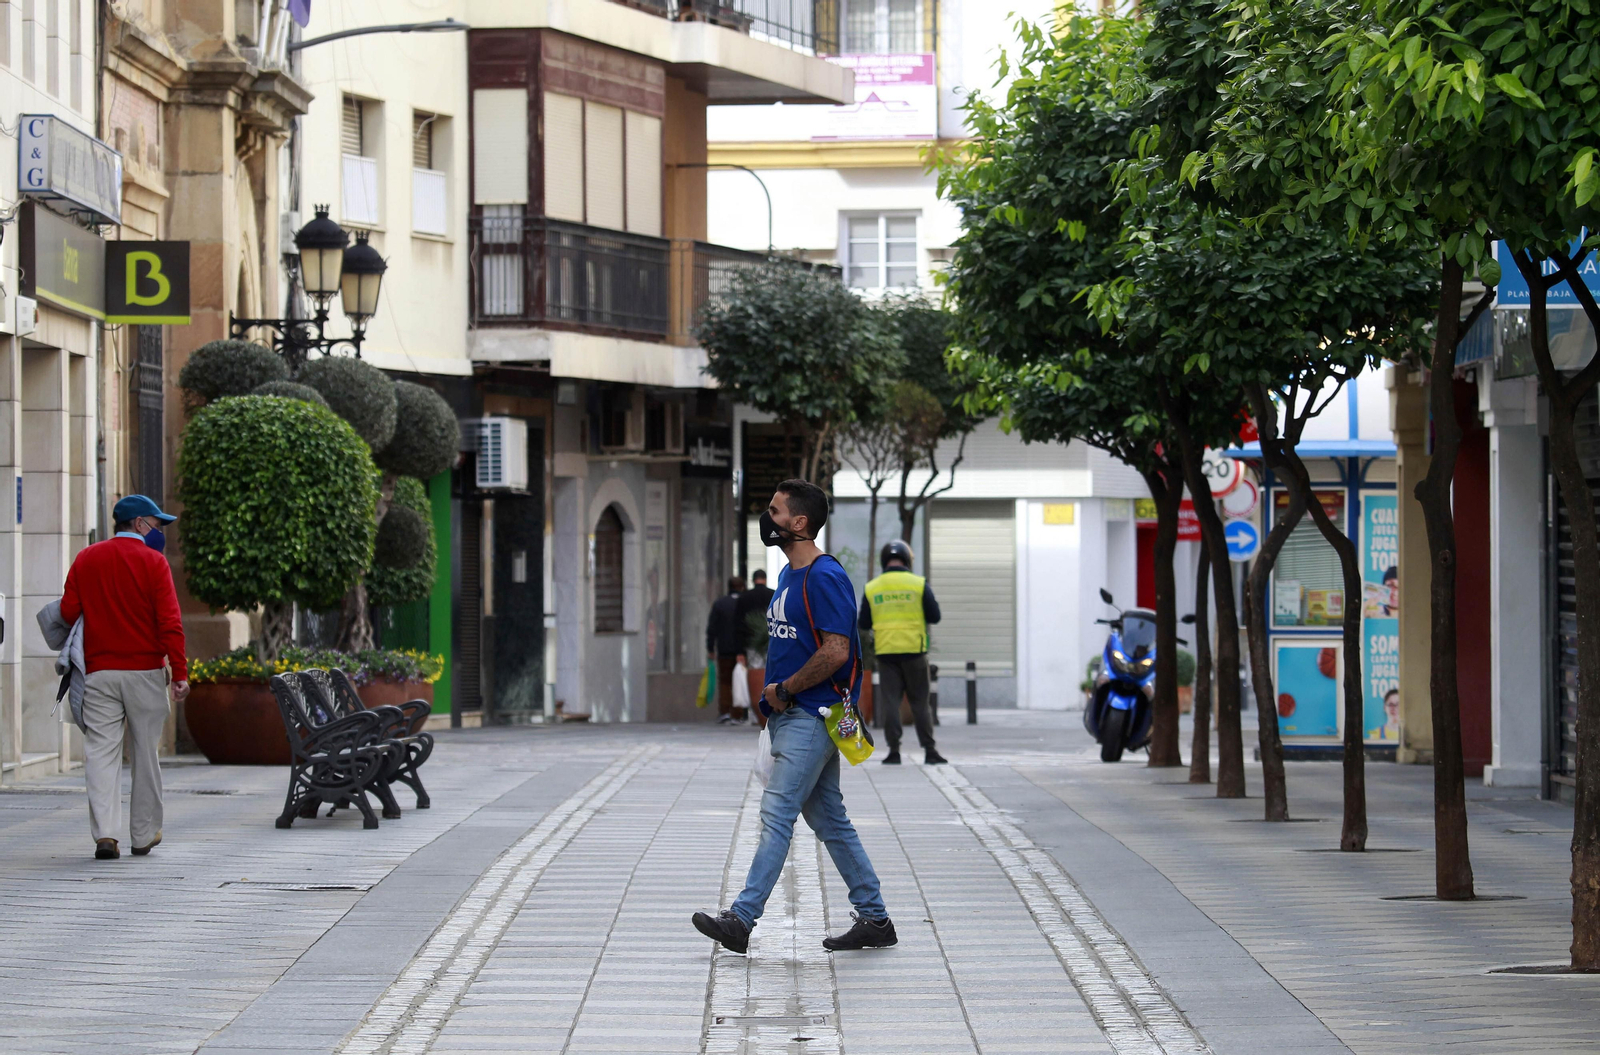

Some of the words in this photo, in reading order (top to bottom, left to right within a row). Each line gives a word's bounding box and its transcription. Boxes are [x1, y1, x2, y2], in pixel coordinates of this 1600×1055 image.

[28, 119, 44, 138] C
[31, 147, 41, 159] &
[27, 167, 44, 187] G
[1202, 460, 1229, 478] 20
[884, 593, 911, 601] ONCE
